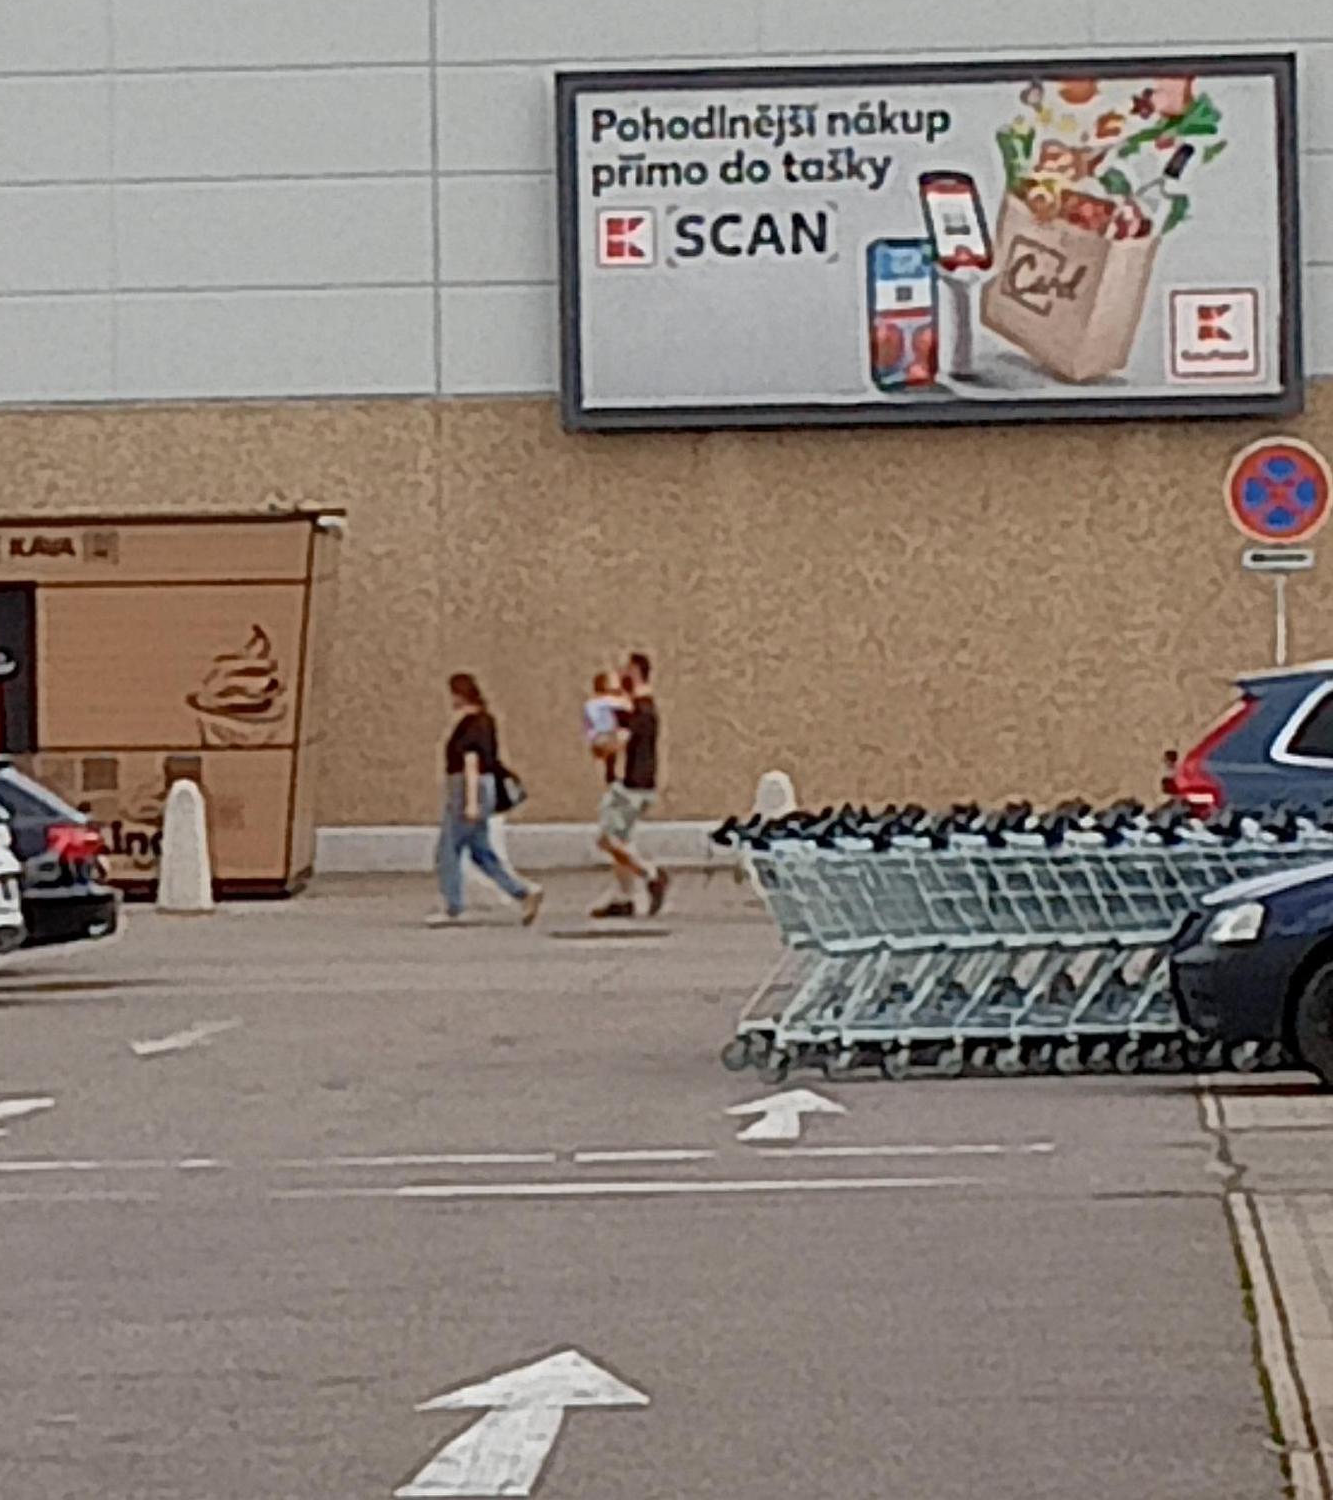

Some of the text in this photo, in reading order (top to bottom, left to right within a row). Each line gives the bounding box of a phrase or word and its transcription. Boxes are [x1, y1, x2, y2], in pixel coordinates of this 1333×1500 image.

[591, 100, 951, 148] Pohodlnější nákup
[591, 146, 893, 198] přímo do tašky
[674, 211, 828, 258] SCAN
